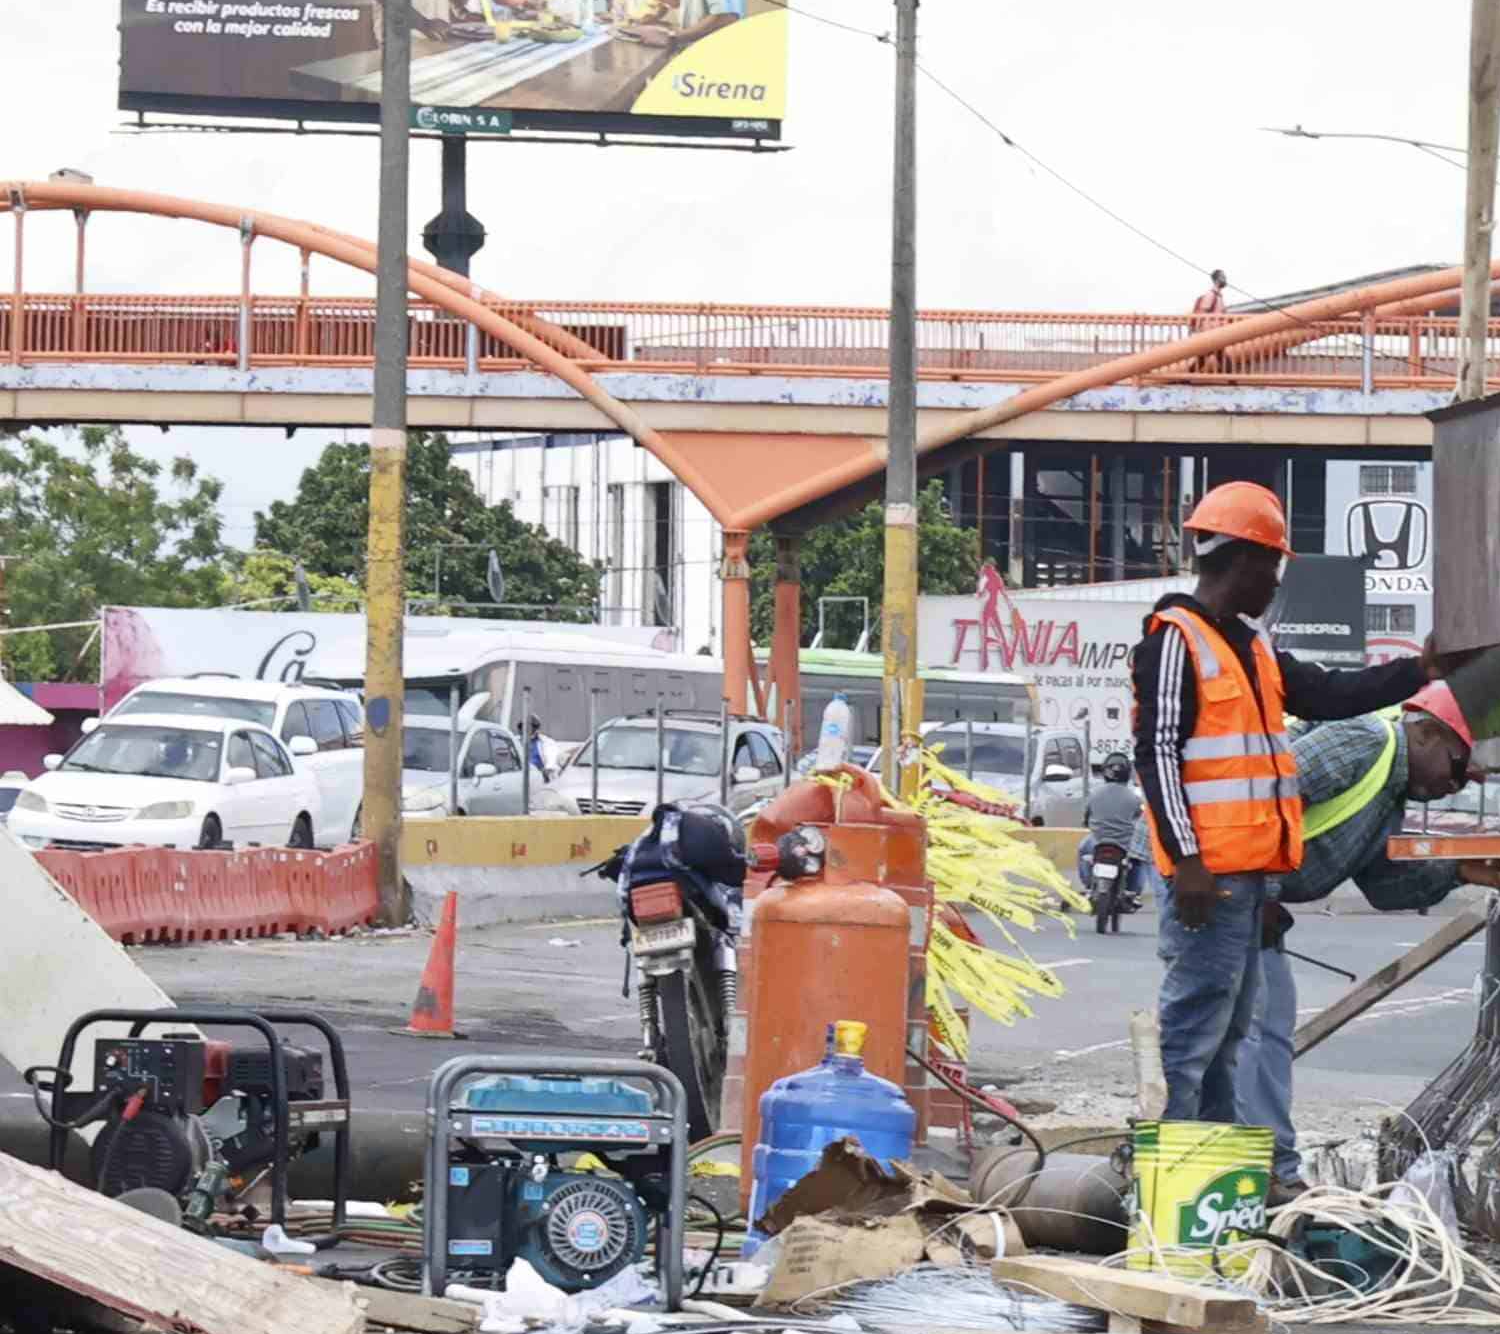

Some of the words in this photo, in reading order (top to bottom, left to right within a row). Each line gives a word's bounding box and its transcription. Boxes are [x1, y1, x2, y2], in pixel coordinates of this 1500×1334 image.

[168, 0, 219, 15] recibir
[221, 1, 300, 19] productos
[302, 4, 359, 21] frescos
[174, 18, 203, 34] con
[206, 19, 222, 34] la
[224, 21, 270, 38] mejor
[272, 22, 331, 38] calidad
[679, 73, 767, 101] Sirena
